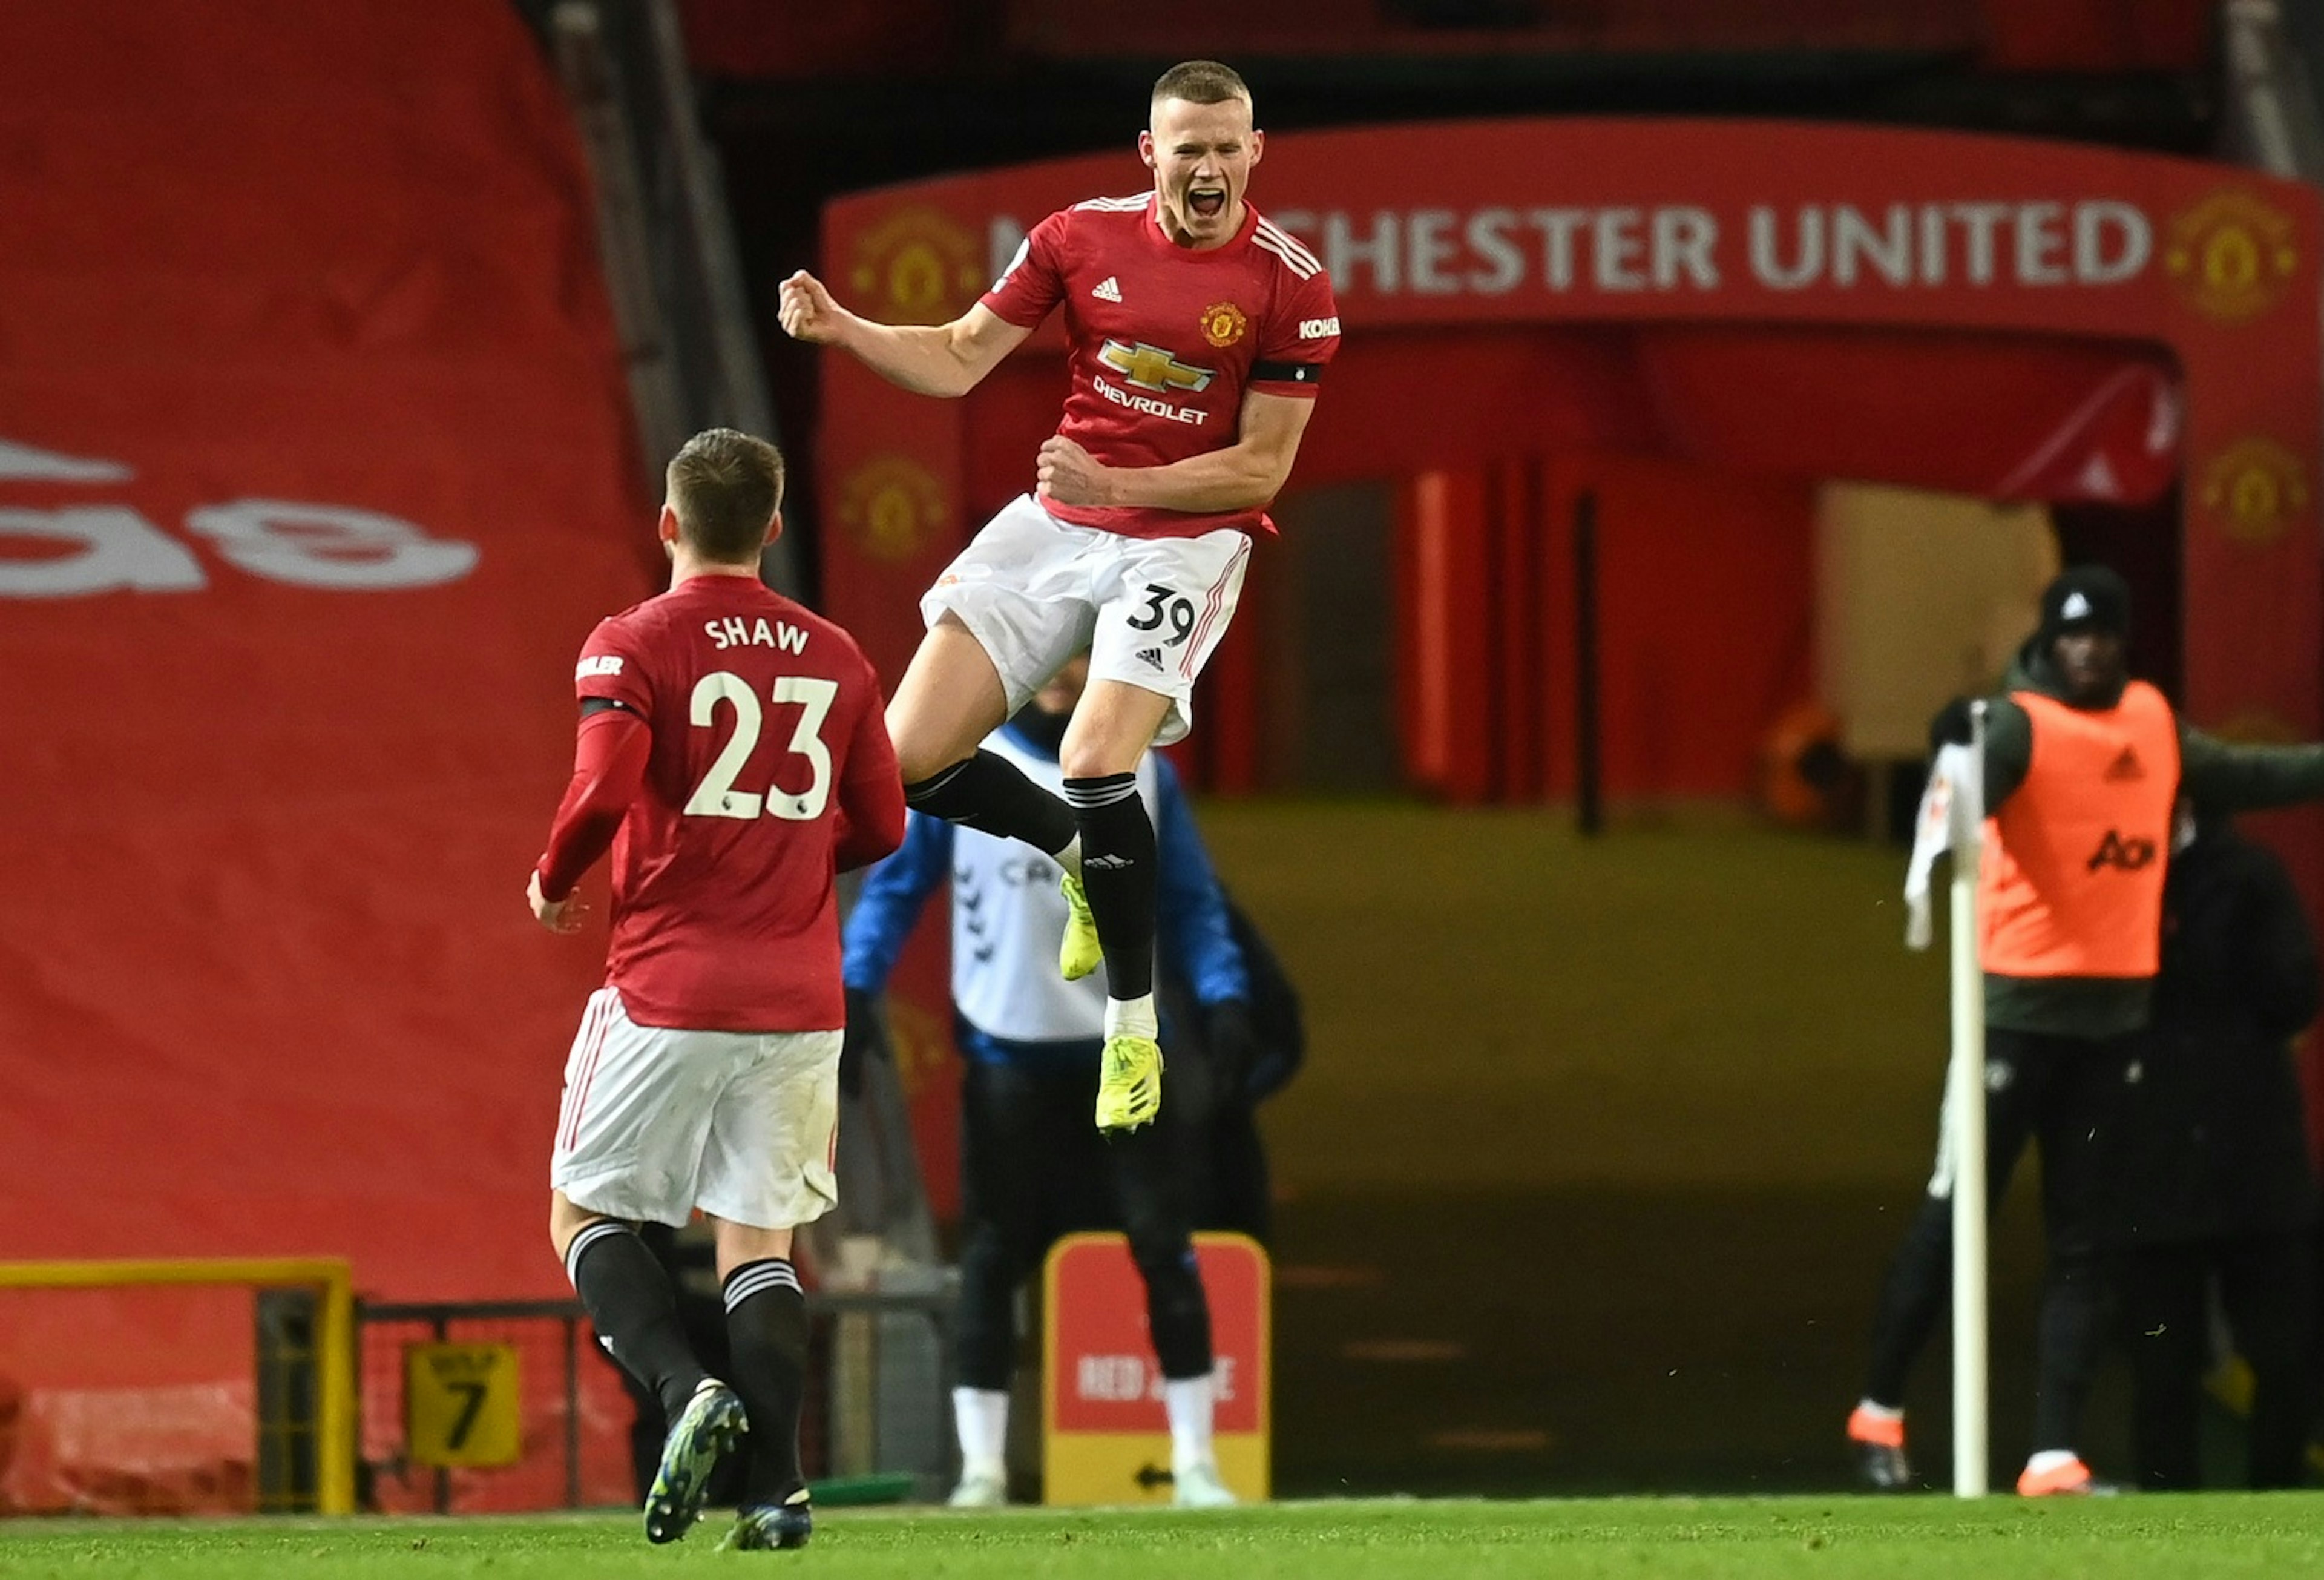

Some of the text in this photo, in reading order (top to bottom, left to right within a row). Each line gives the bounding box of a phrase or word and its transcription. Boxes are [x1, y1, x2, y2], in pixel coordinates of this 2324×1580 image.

[1748, 202, 2152, 289] UNITED
[1092, 375, 1209, 425] CHEVROLET
[704, 617, 809, 656] SHAW
[1126, 584, 1195, 648] 39
[683, 671, 839, 820] 23
[446, 1381, 488, 1450] 7
